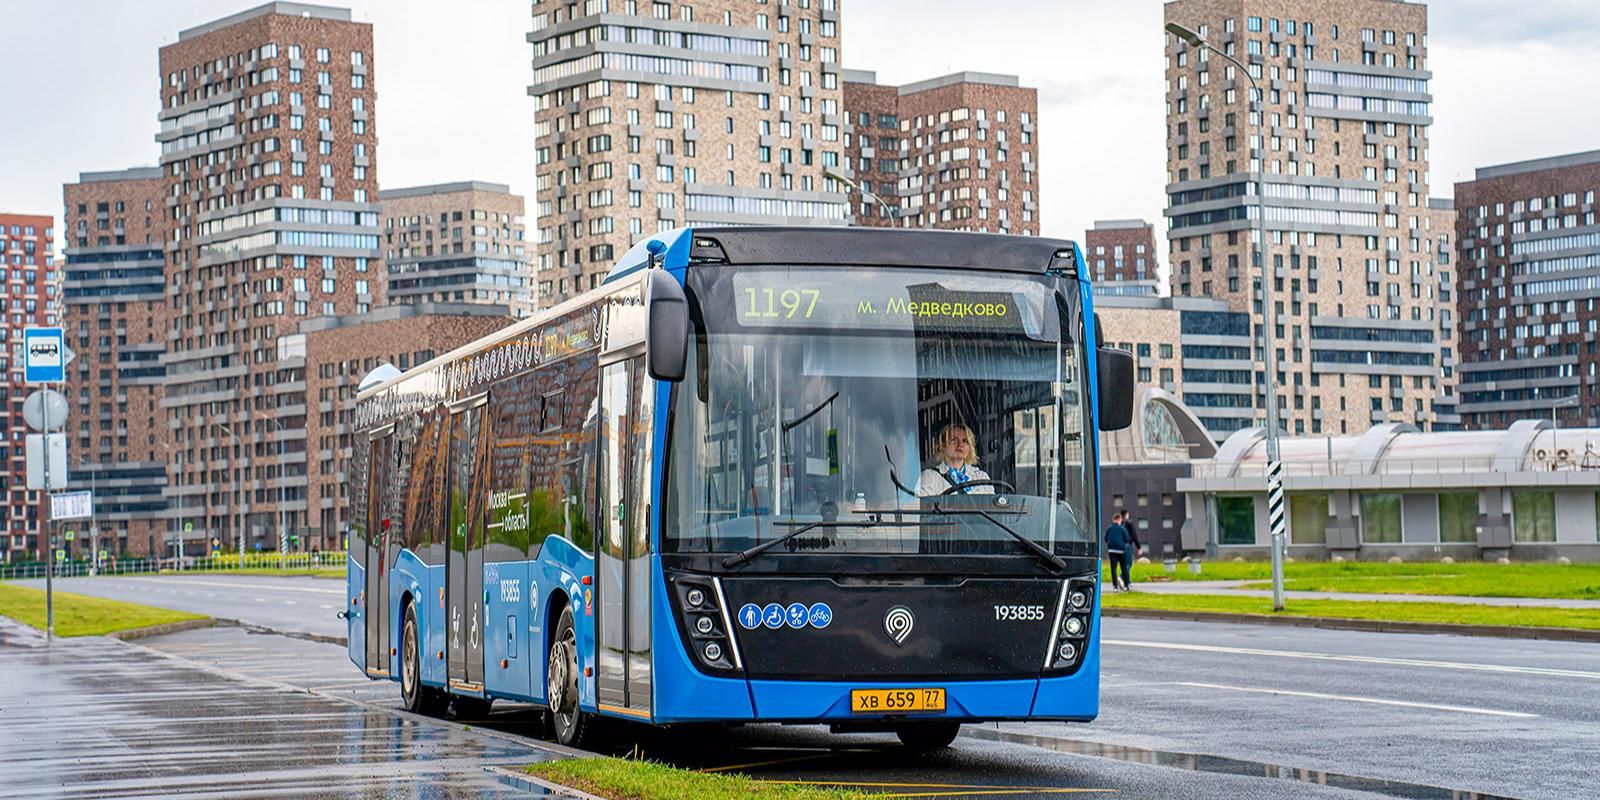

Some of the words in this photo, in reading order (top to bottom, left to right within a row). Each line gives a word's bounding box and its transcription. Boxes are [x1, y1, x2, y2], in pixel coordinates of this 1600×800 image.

[744, 287, 820, 319] 1197
[857, 300, 877, 315] м.
[886, 297, 1007, 318] Медведково
[488, 489, 508, 510] Москва
[500, 579, 520, 602] 193855
[993, 604, 1045, 621] 193855
[886, 691, 915, 708] 659
[925, 690, 940, 703] 77
